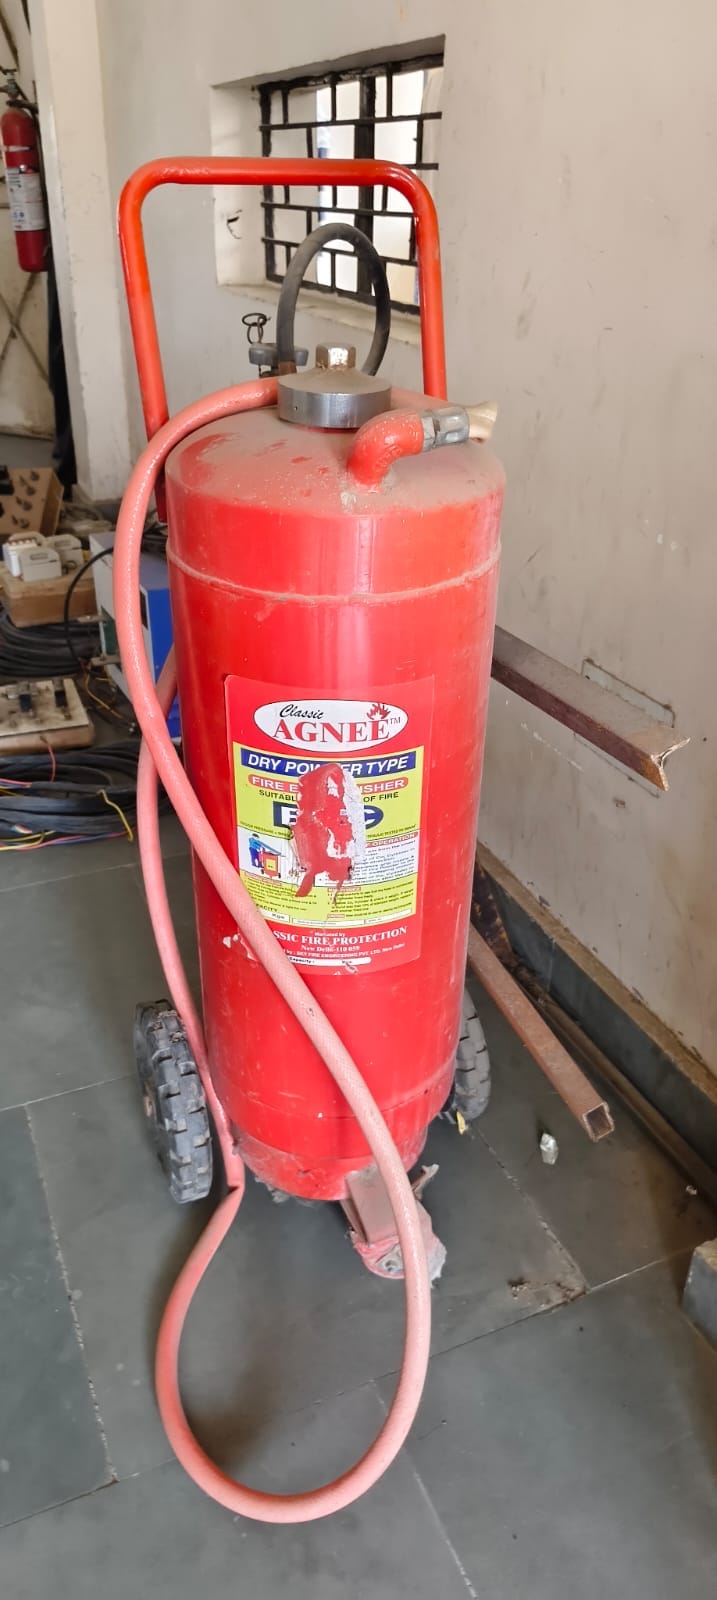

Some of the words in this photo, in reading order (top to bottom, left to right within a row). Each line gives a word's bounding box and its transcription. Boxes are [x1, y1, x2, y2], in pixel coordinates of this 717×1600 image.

[279, 704, 324, 720] Classic
[273, 718, 390, 744] AGNEE
[390, 716, 401, 725] TM
[248, 753, 282, 771] DRY
[285, 761, 363, 775] POER
[367, 756, 409, 774] TYPE
[252, 776, 284, 790] FIRE
[259, 789, 298, 802] SUITABL
[363, 795, 376, 803] OF
[379, 791, 399, 801] FIRE
[273, 930, 299, 943] SSIC
[301, 936, 330, 945] FIRE
[333, 926, 408, 946] PROTECTION
